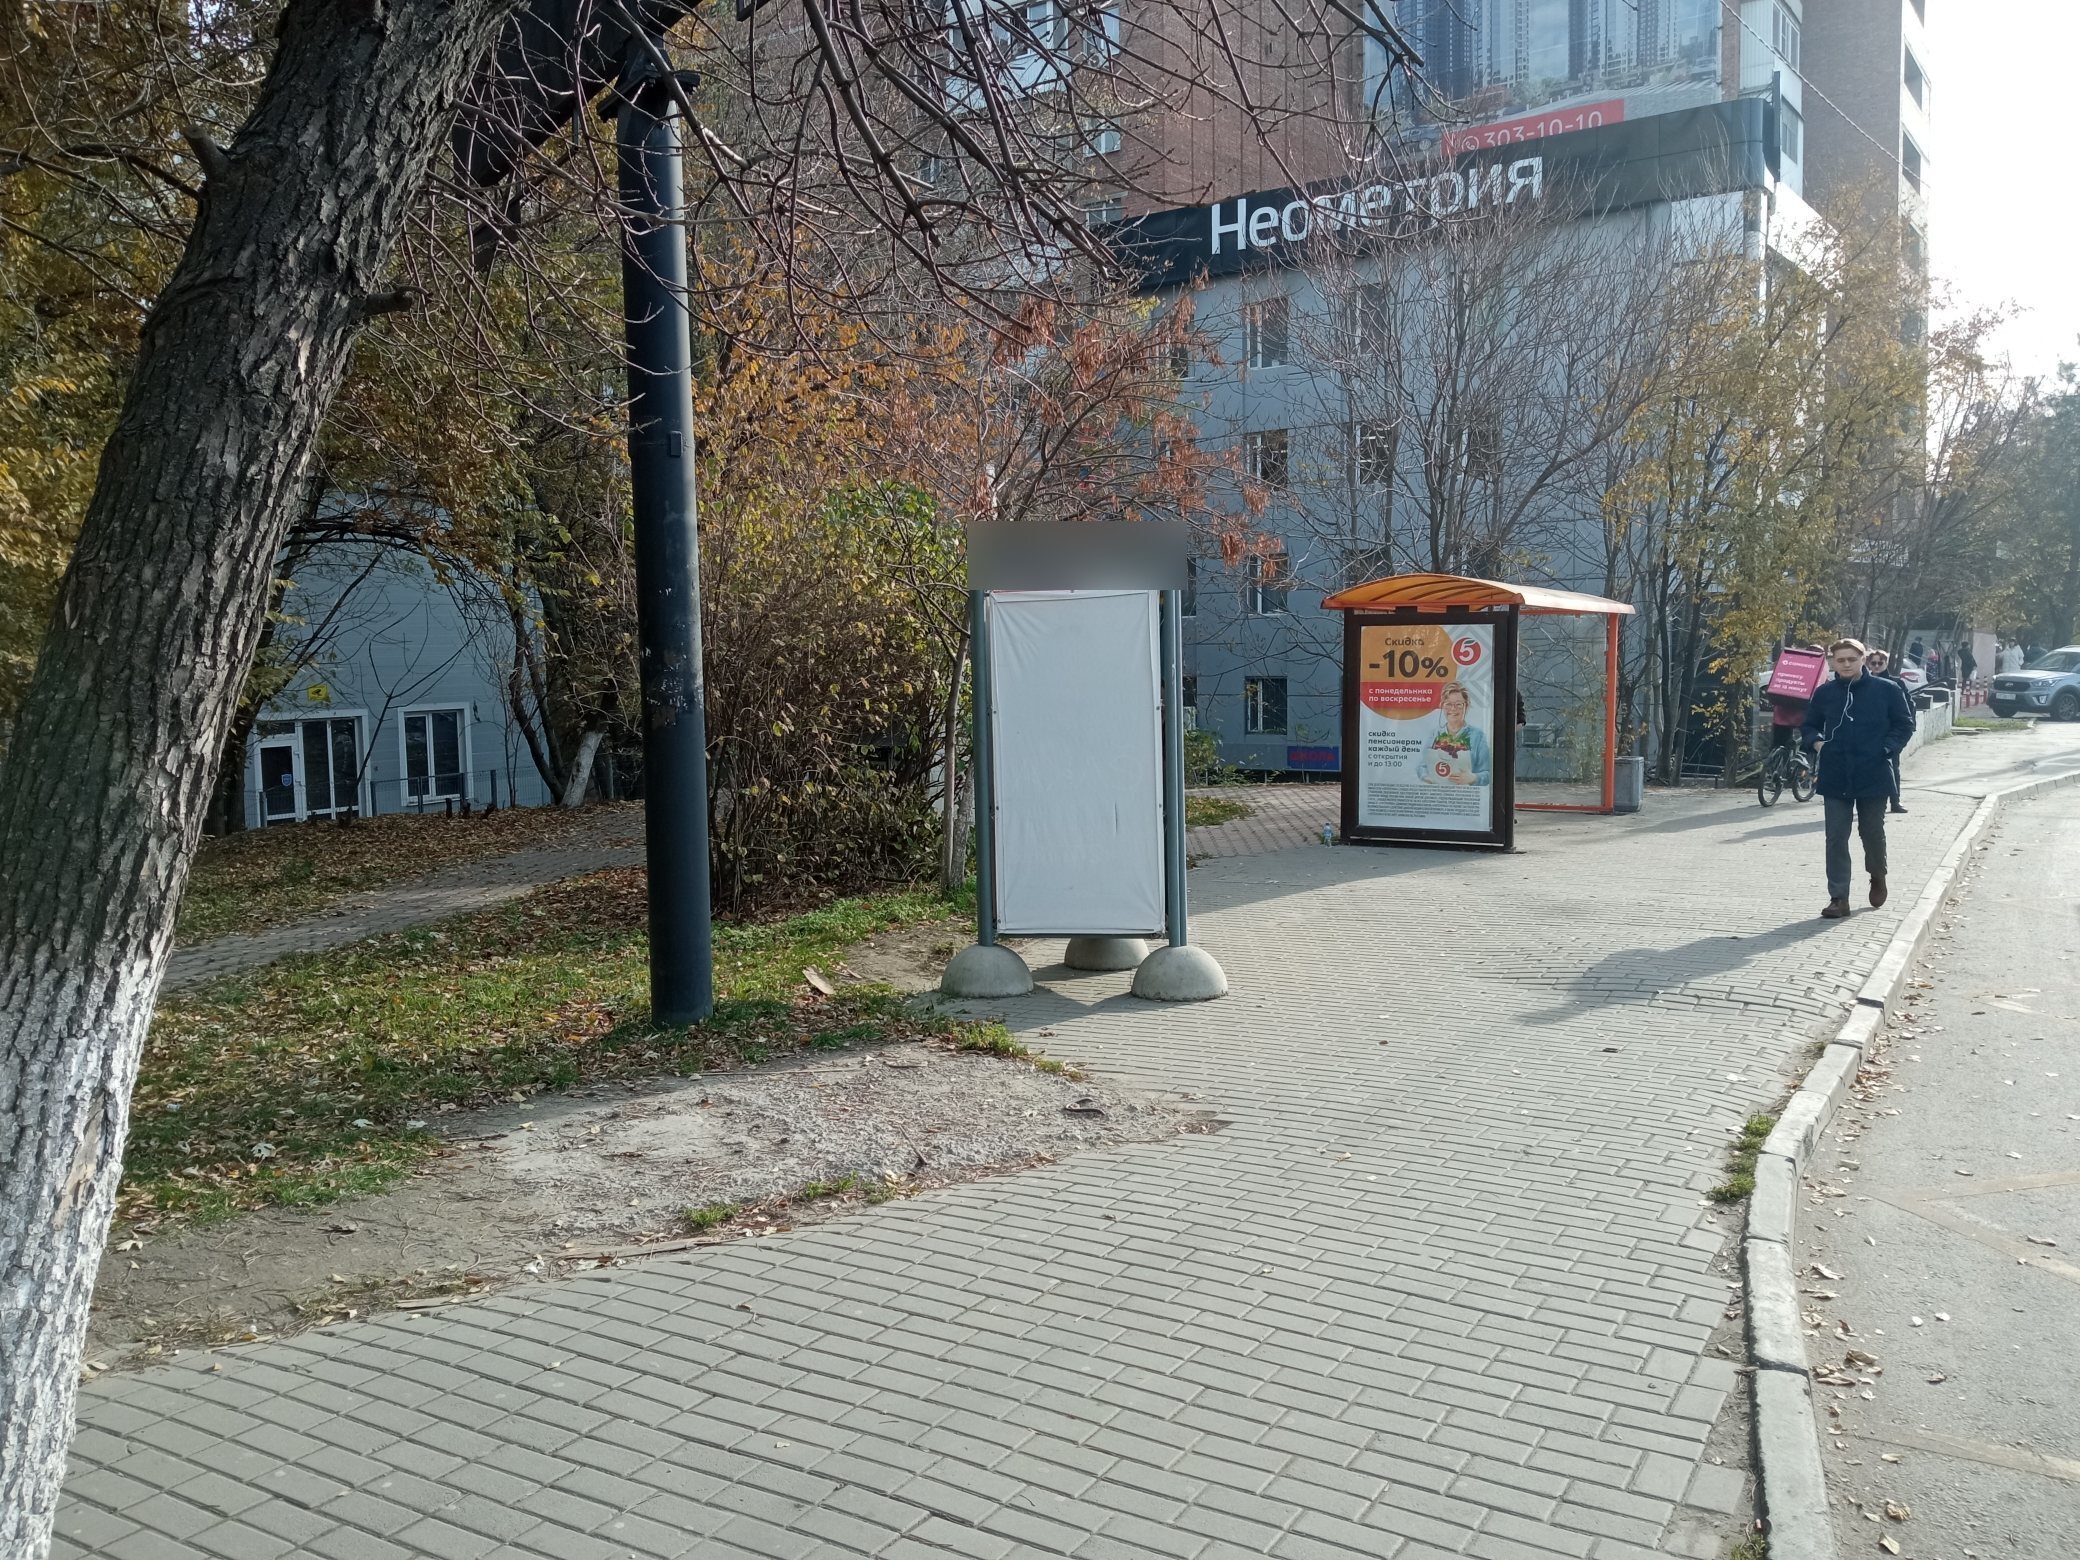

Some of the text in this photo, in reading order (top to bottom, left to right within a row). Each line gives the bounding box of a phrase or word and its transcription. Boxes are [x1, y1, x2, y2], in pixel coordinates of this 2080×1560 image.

[1484, 111, 1602, 147] 303-10-10
[1210, 156, 1543, 255] Неометрия
[1385, 637, 1425, 646] Скидка
[1369, 650, 1449, 678] -10%
